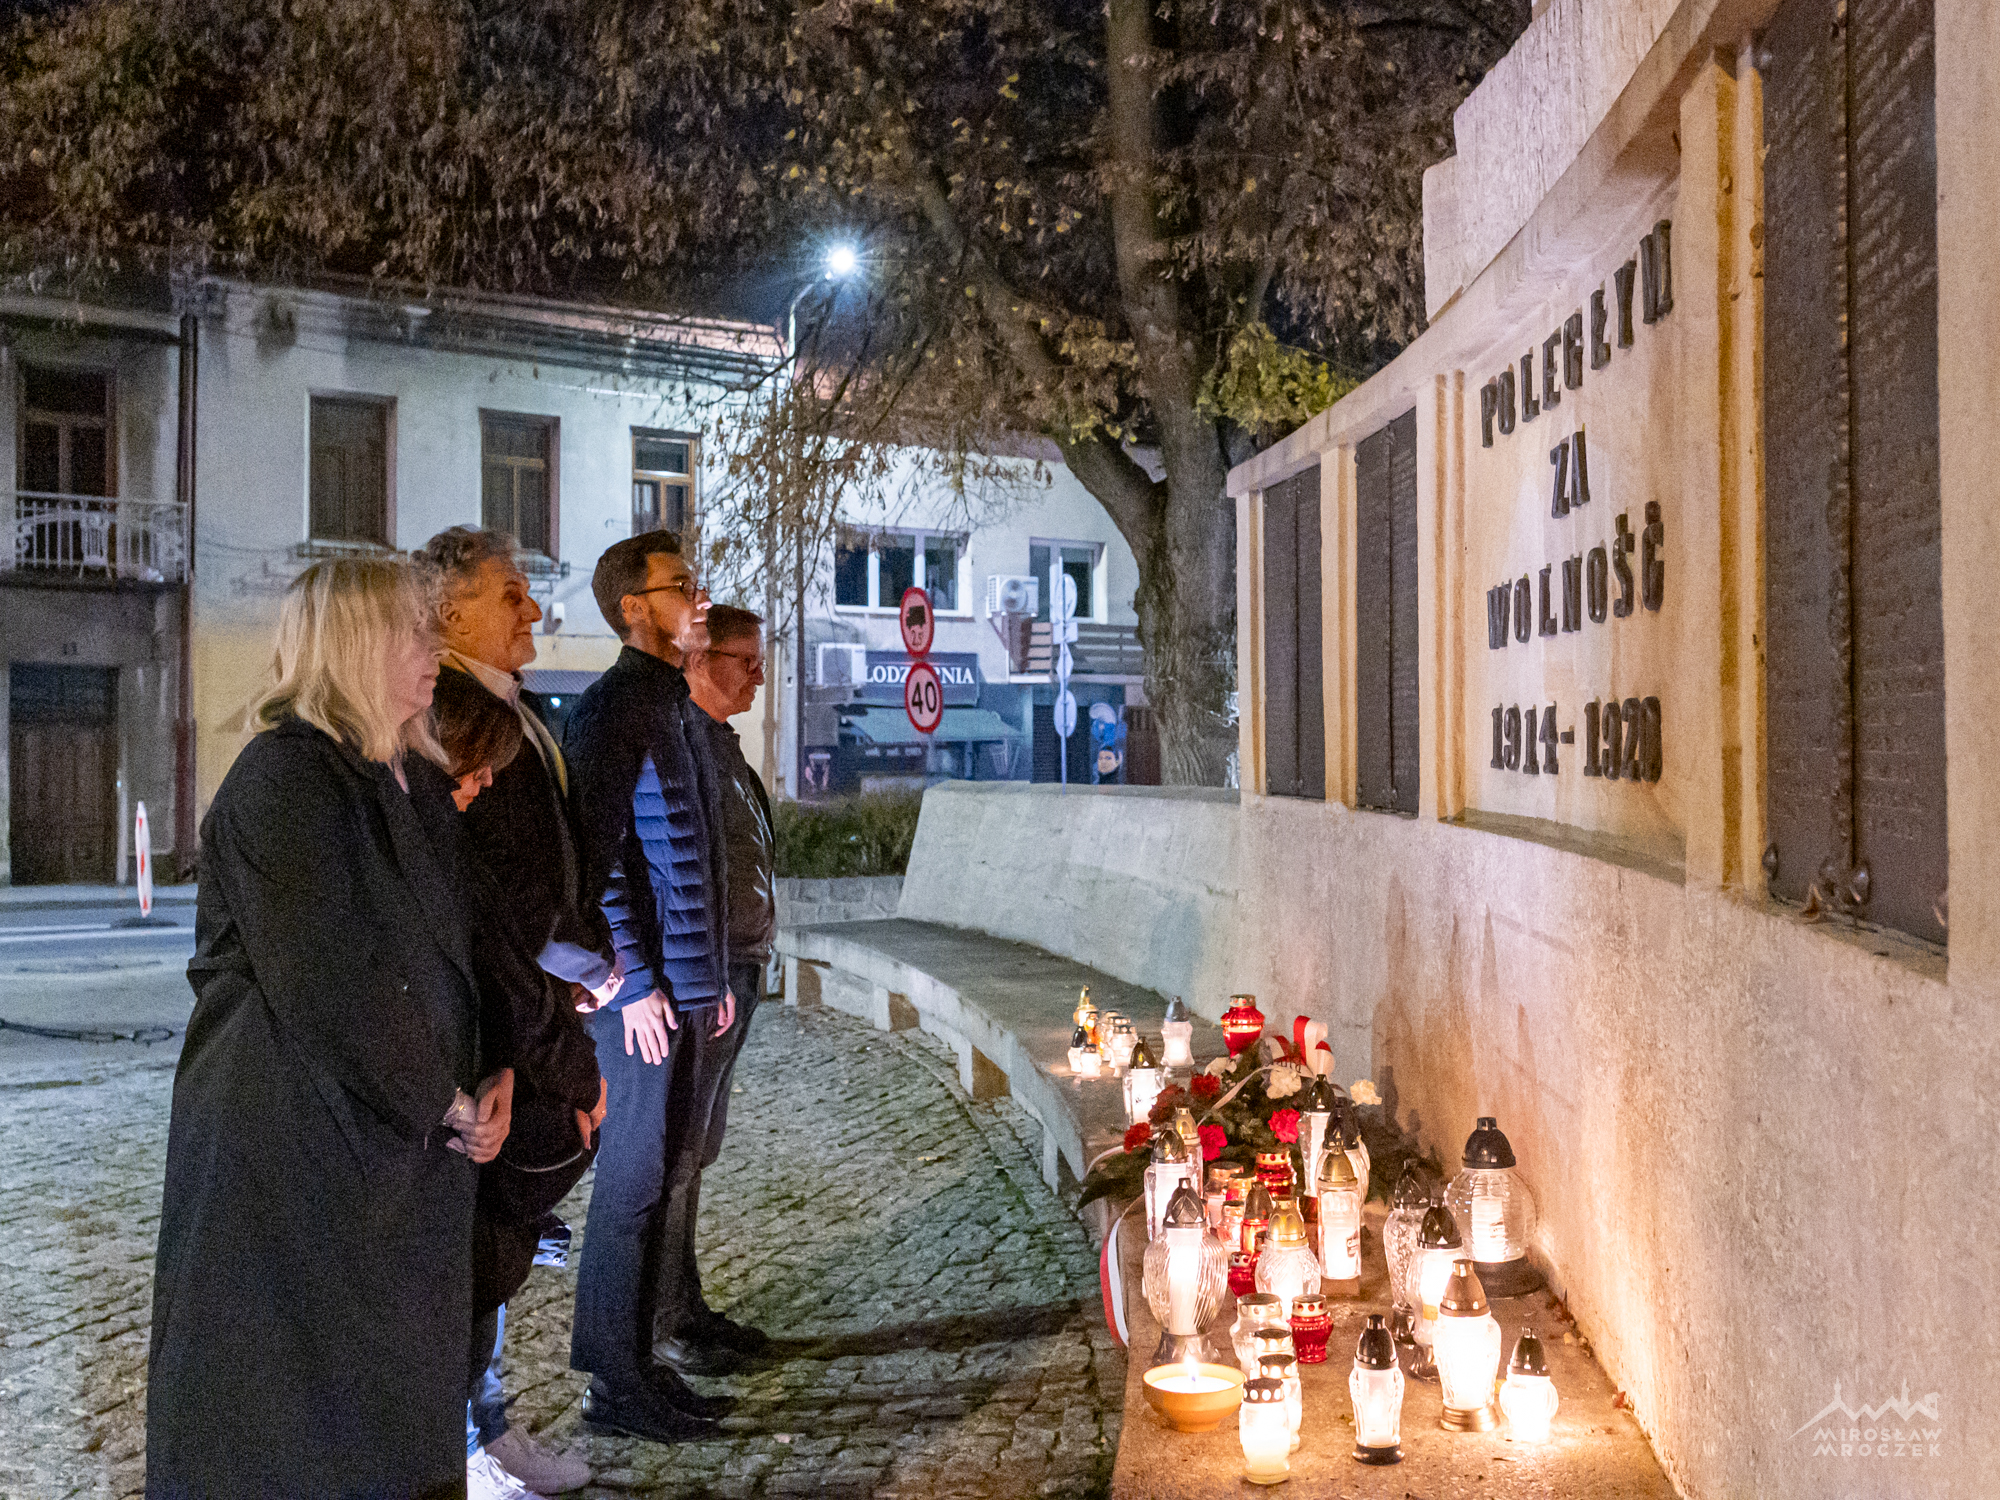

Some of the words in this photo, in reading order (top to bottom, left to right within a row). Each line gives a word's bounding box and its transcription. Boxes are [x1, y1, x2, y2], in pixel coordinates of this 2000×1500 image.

[1550, 428, 1590, 519] ZA
[1486, 500, 1664, 650] WOLNOŚĆ
[865, 664, 975, 685] LODZNIA
[911, 681, 937, 715] 40
